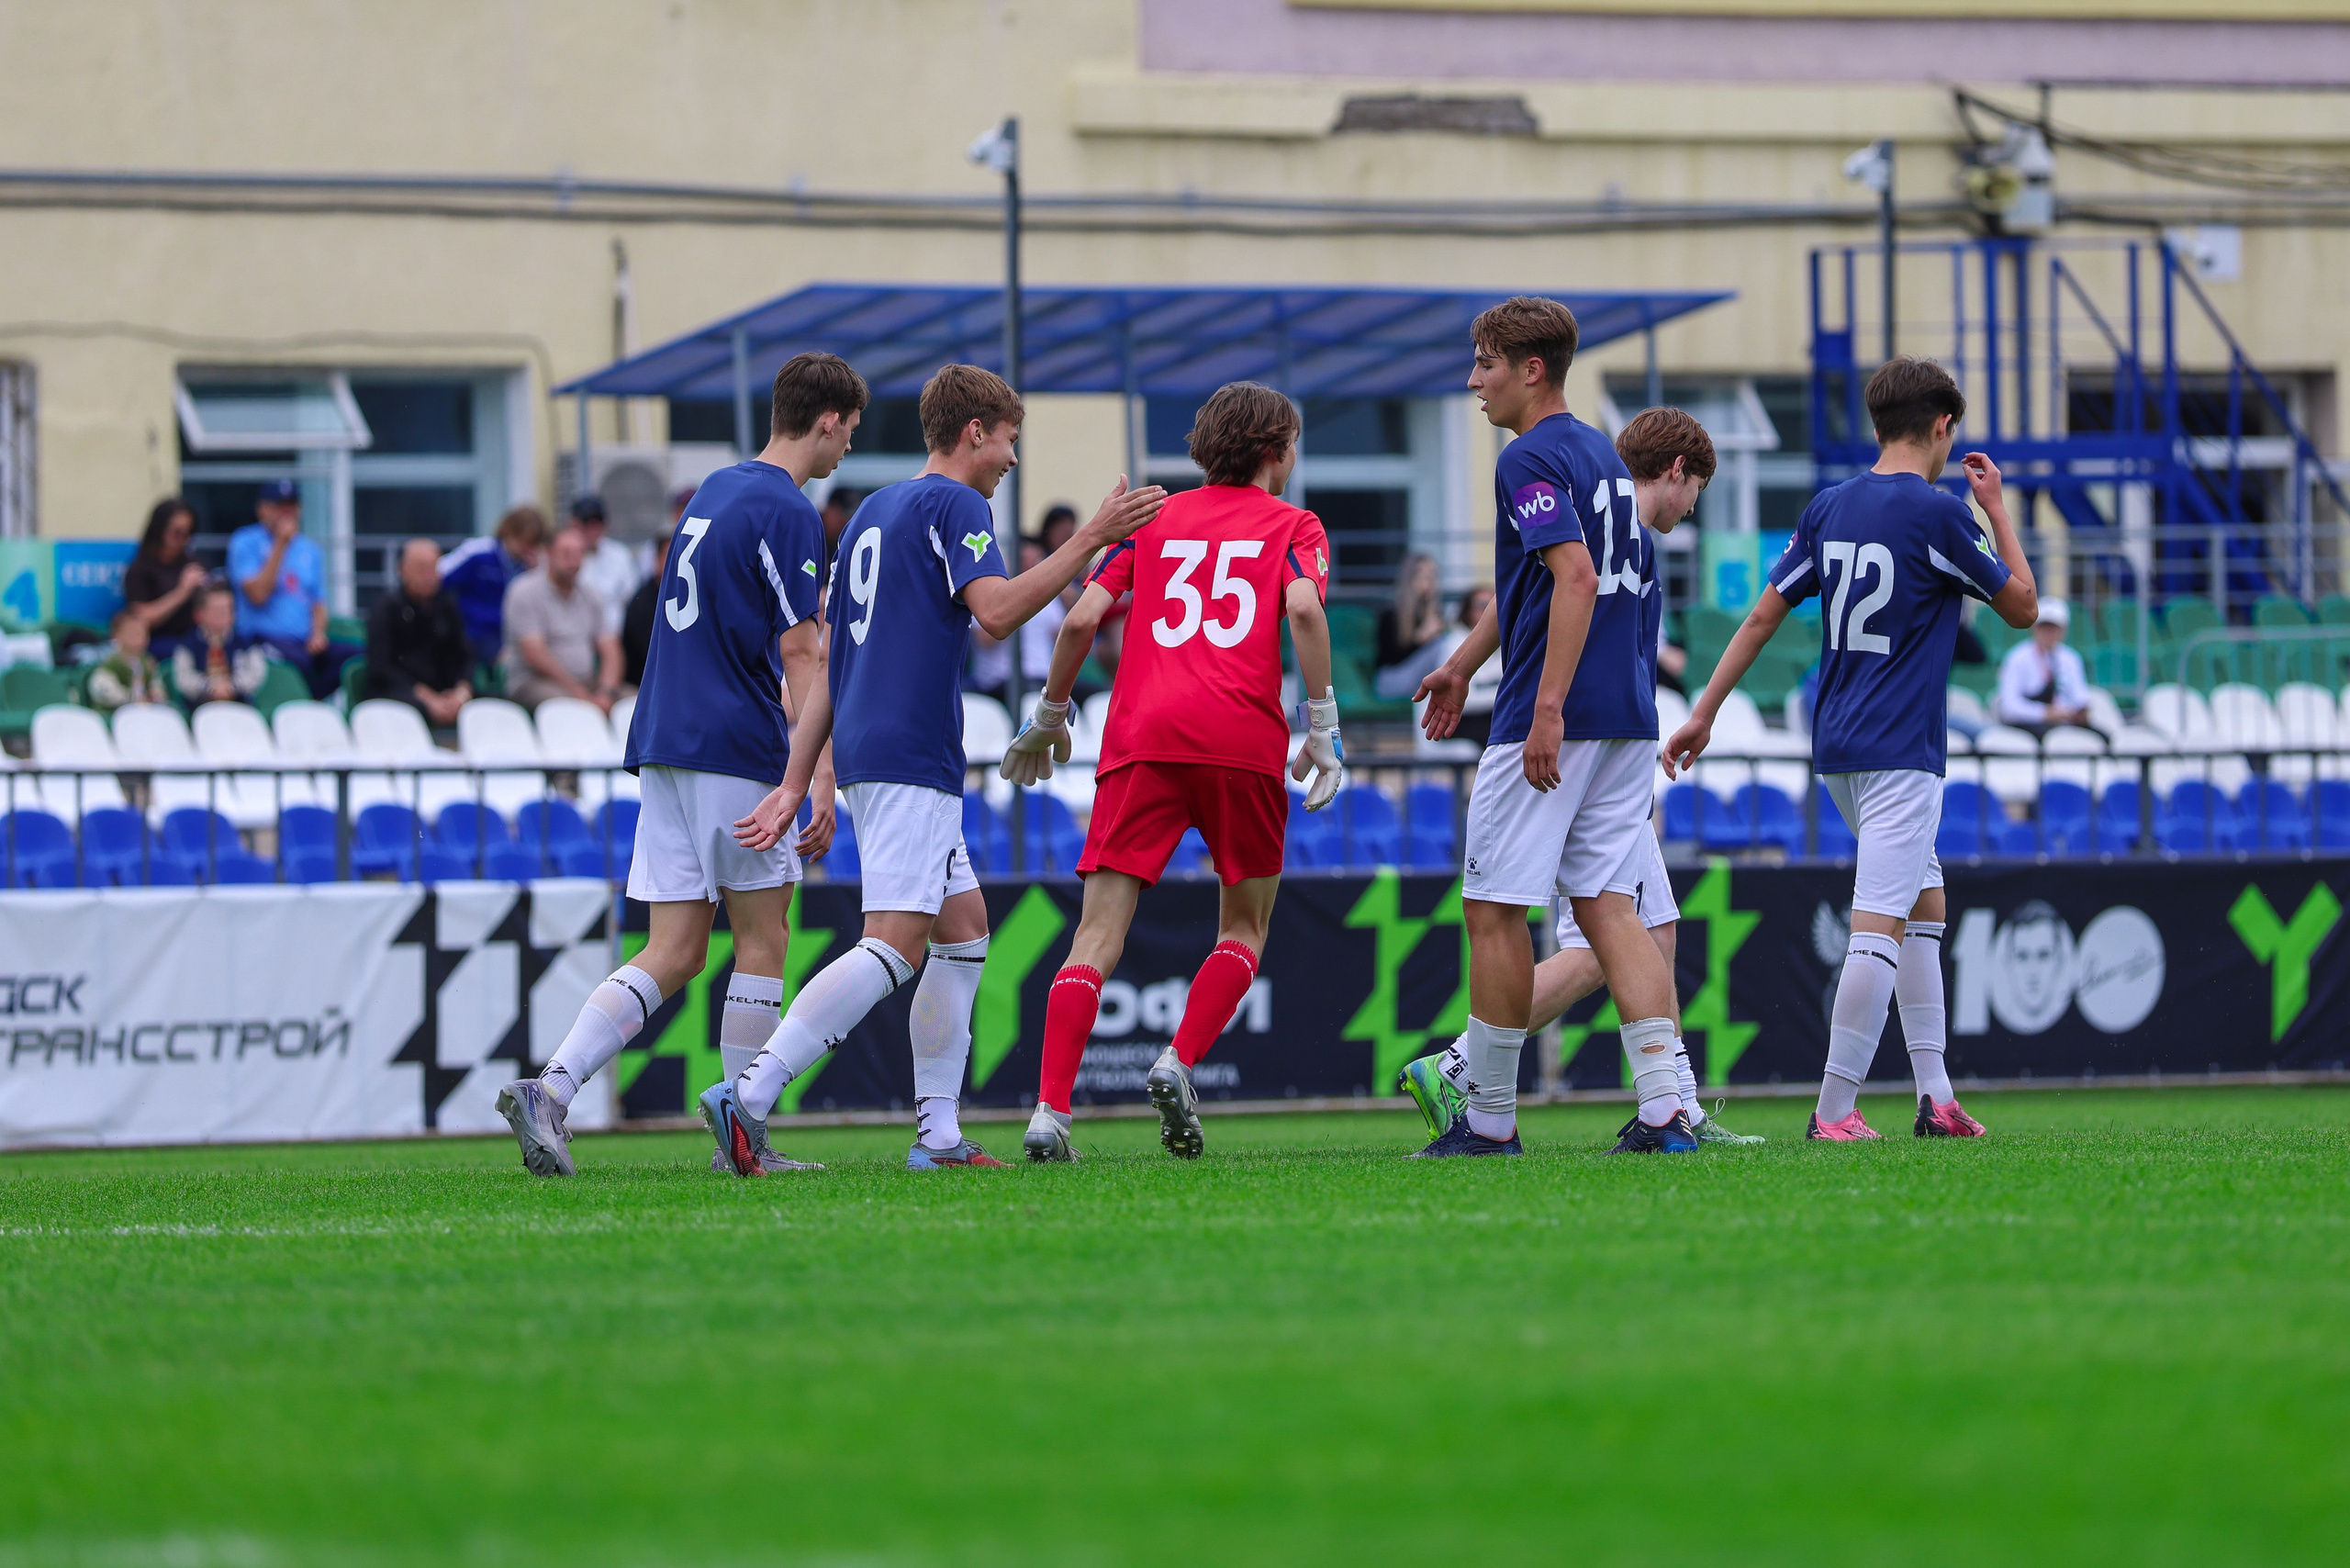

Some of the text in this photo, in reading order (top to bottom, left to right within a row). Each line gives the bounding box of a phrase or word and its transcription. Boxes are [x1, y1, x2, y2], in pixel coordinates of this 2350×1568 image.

[1517, 490, 1556, 519] wb
[1593, 477, 1641, 595] 13
[665, 516, 712, 633] 3
[849, 526, 881, 646] 9
[1151, 539, 1266, 649] 35
[1822, 541, 1895, 655] 72
[0, 1007, 353, 1071] РАНССТРОЙ
[728, 995, 773, 1008] KELME
[1056, 977, 1098, 991] KELME
